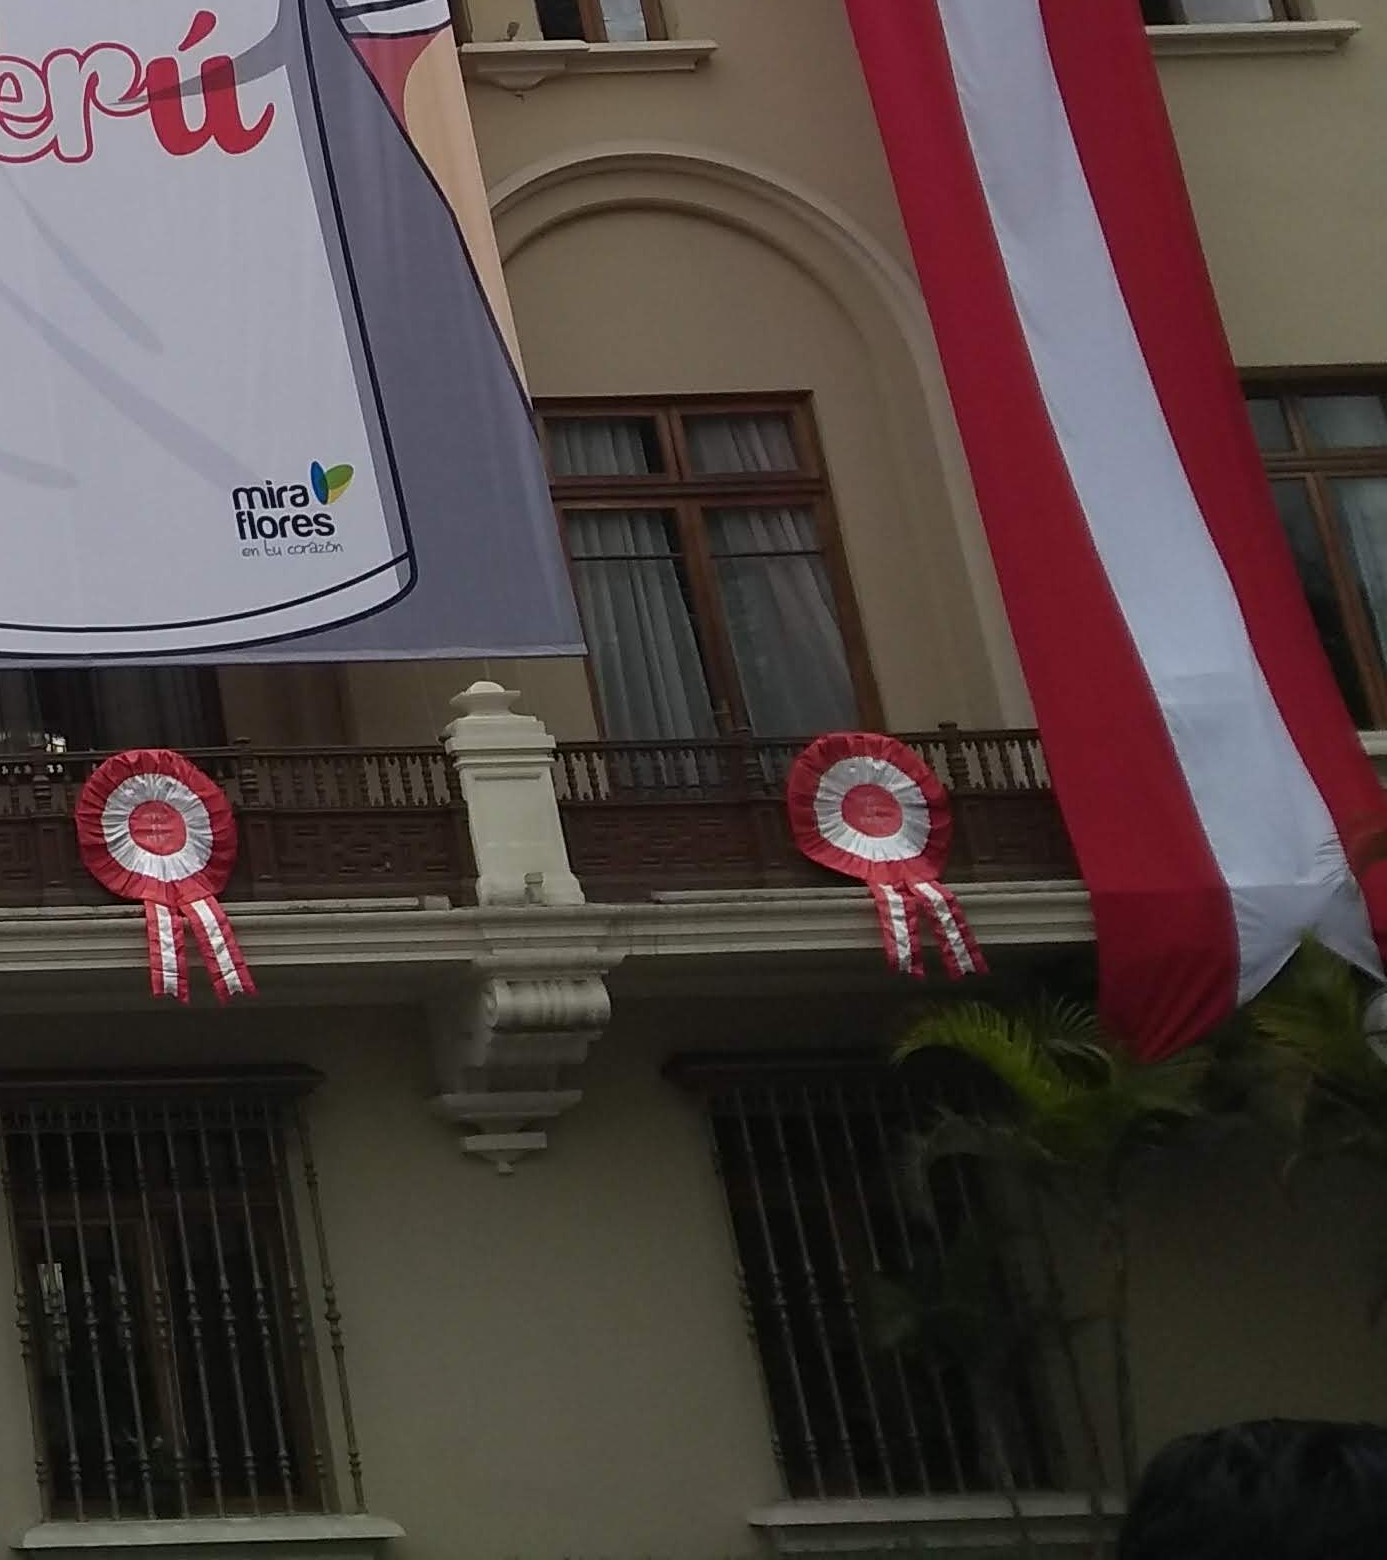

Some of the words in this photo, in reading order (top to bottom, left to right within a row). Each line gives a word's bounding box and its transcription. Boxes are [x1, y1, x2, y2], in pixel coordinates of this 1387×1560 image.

[231, 479, 310, 511] mira
[234, 510, 336, 541] flores
[241, 546, 260, 558] en
[263, 539, 283, 557] tu
